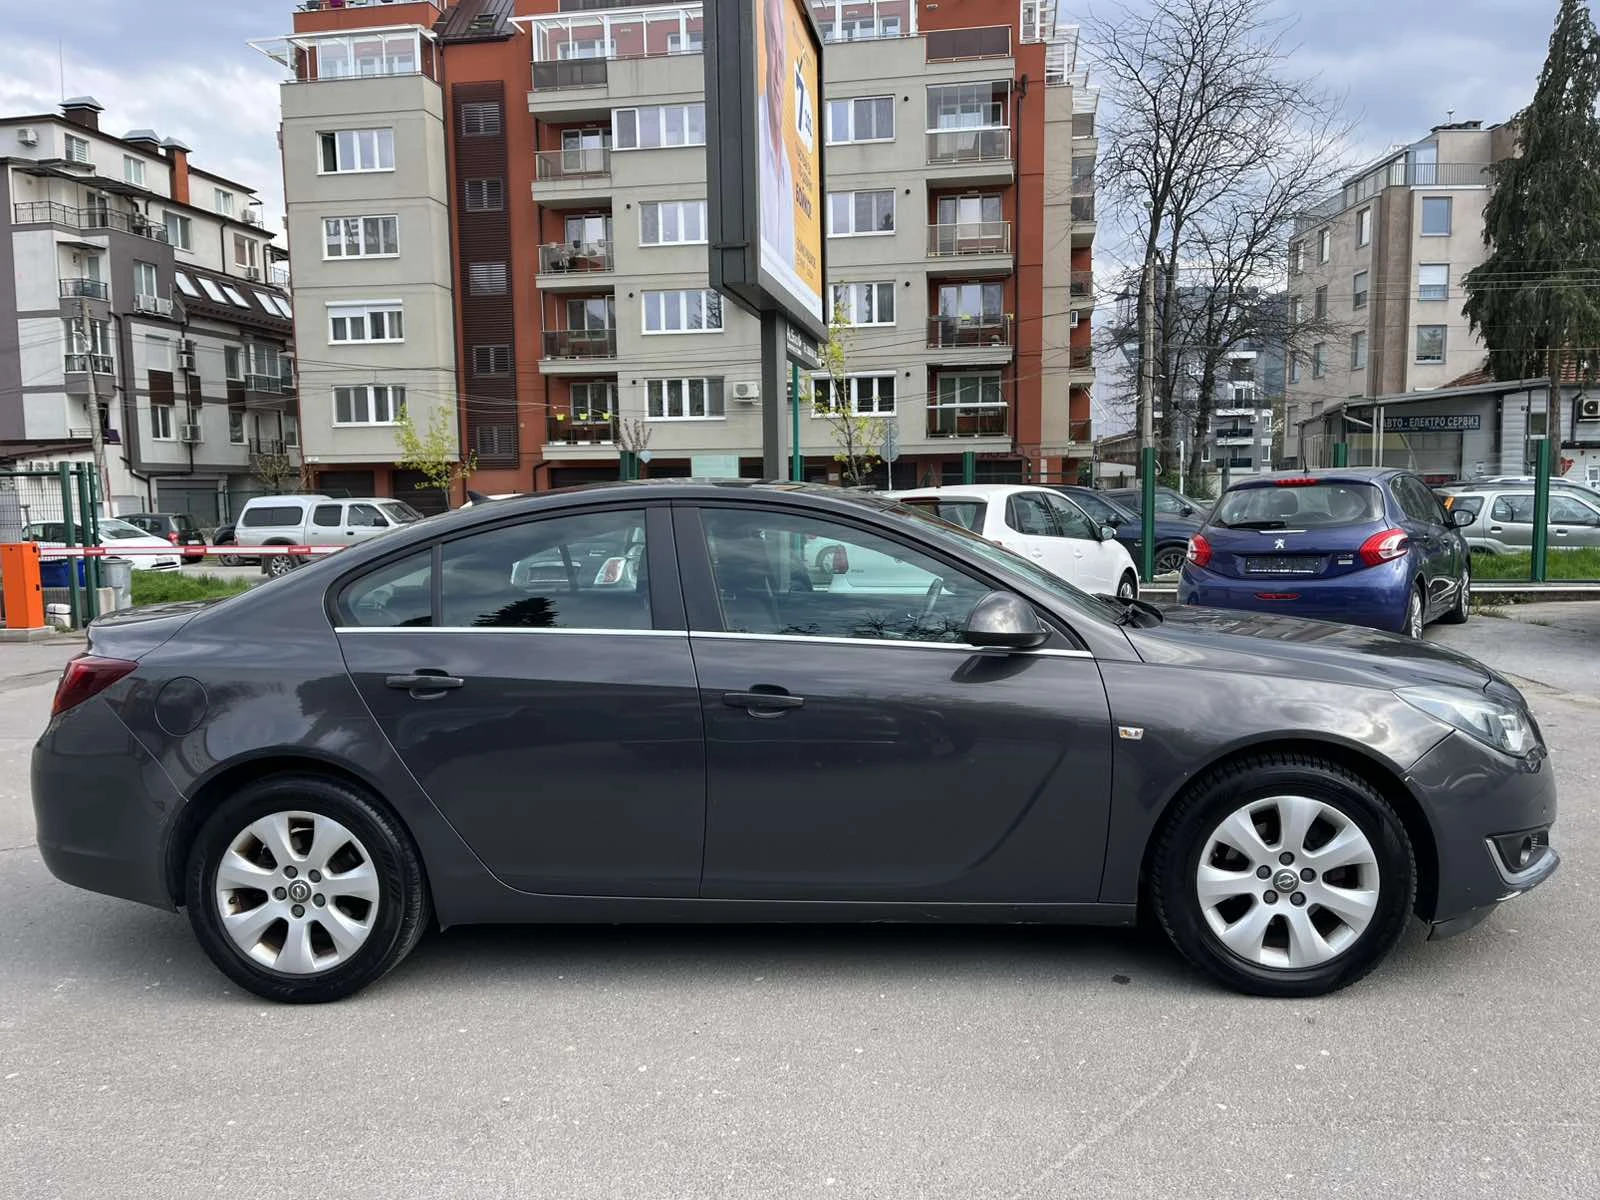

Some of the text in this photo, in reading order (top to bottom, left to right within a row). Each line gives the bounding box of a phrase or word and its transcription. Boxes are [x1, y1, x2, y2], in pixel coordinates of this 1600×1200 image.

[795, 70, 804, 132] 7
[1409, 417, 1446, 427] ЕЛЕКТРО
[1447, 416, 1479, 426] СЕРВИЗ
